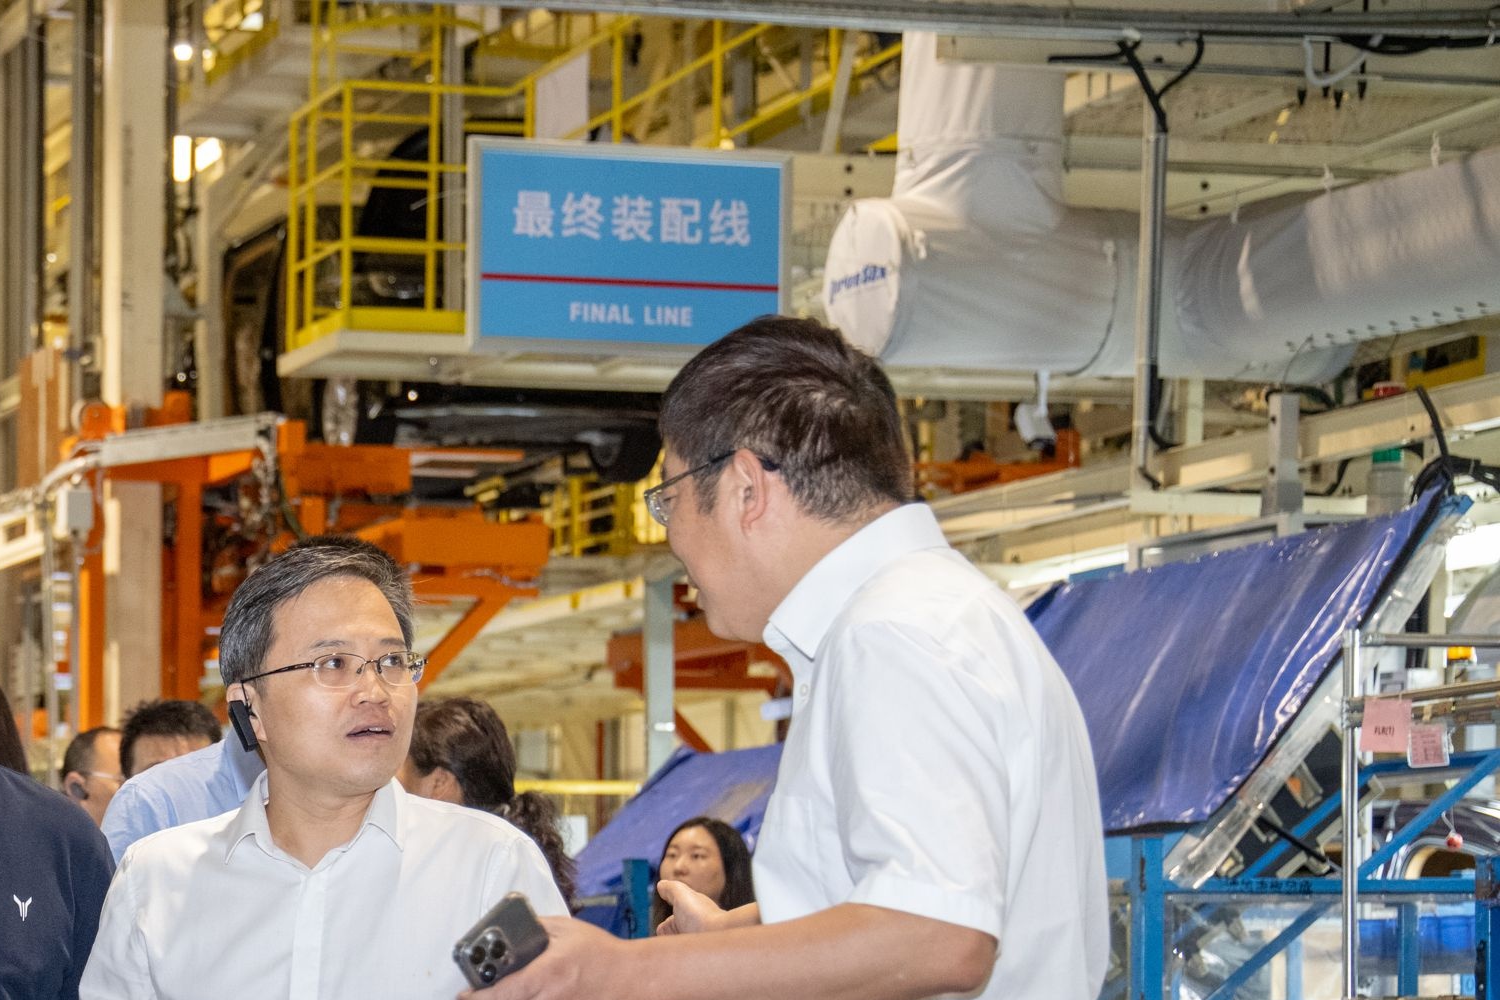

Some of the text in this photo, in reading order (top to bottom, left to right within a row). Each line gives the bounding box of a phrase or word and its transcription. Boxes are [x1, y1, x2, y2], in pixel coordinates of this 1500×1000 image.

[513, 190, 751, 247] 最终装配线
[569, 301, 693, 327] FINAL LINE
